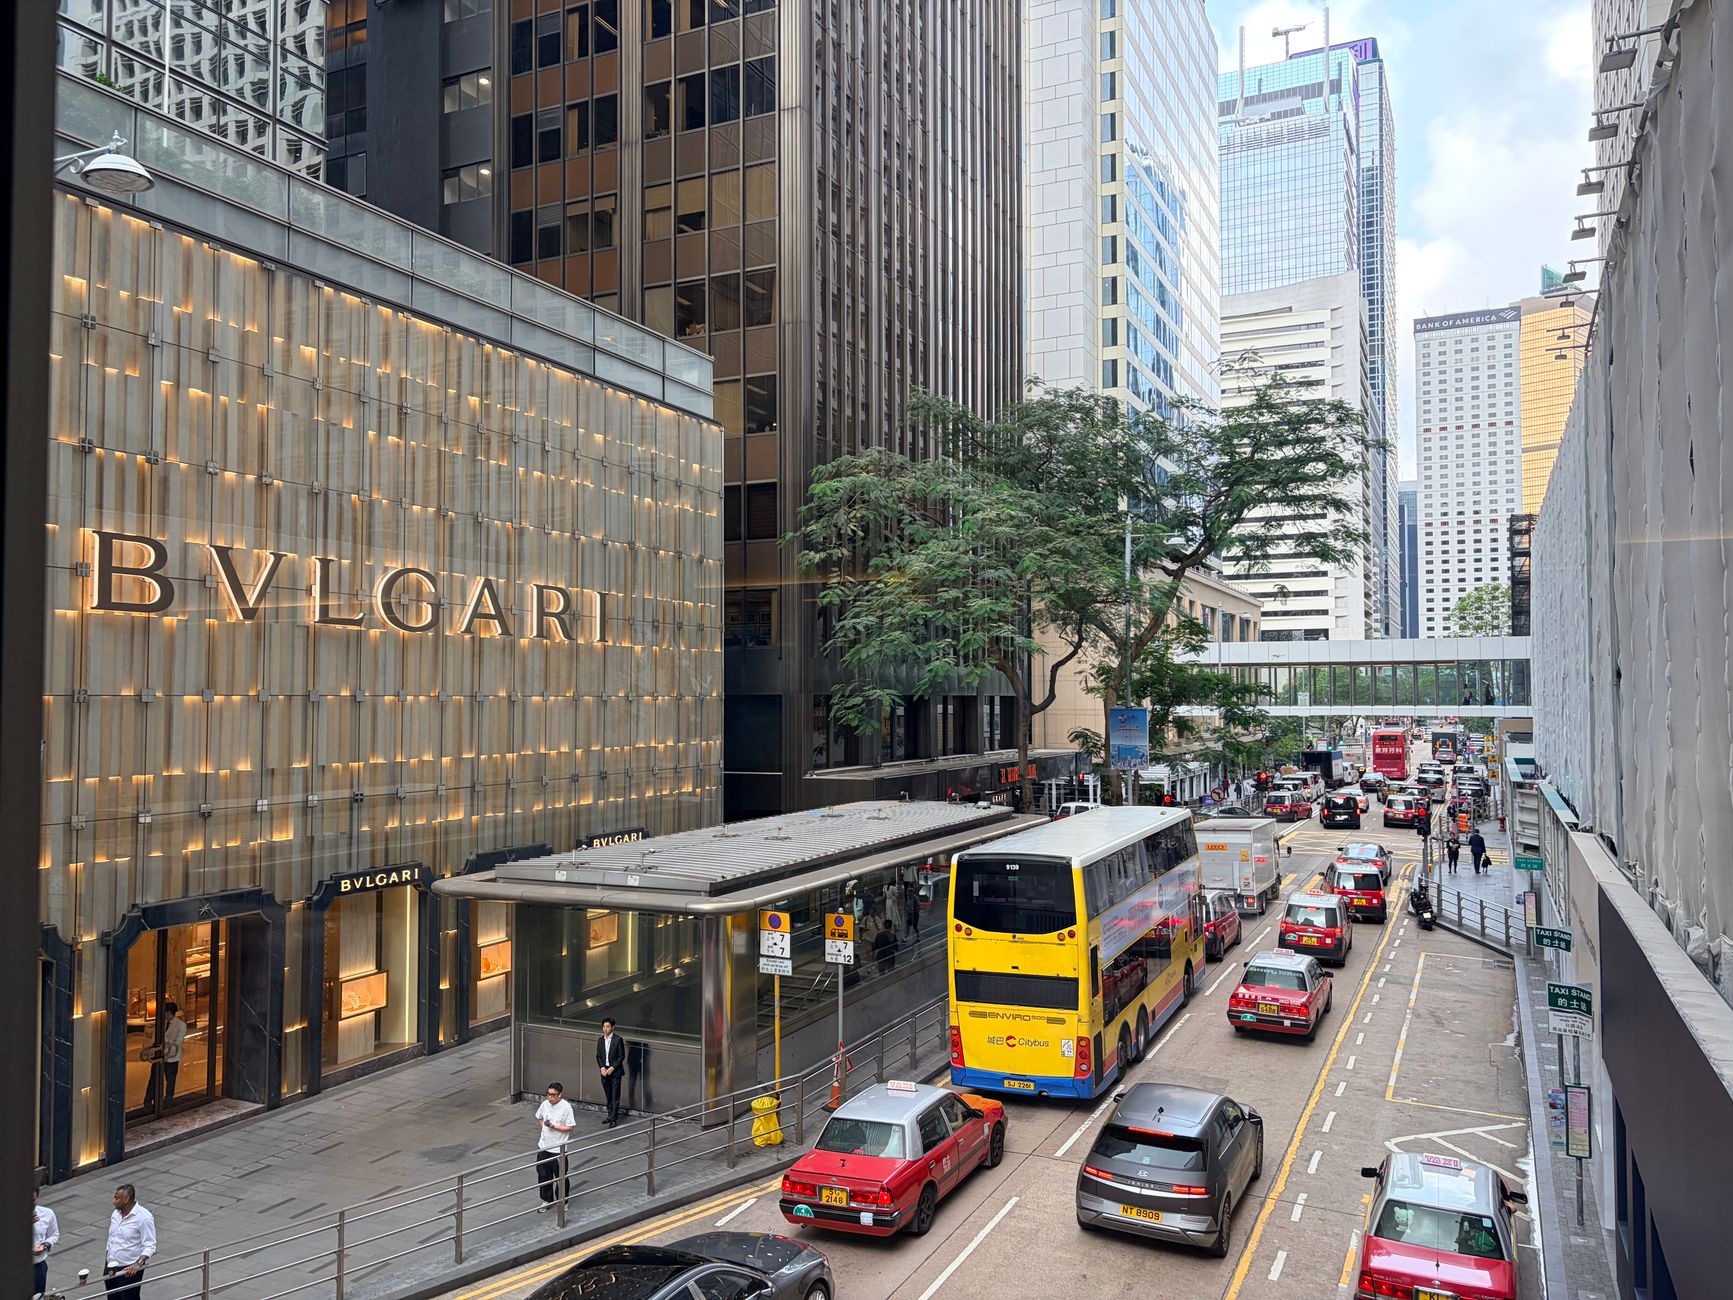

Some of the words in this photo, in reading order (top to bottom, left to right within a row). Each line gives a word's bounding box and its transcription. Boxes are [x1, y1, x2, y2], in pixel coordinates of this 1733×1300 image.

[1416, 321, 1440, 330] BANK
[1455, 314, 1497, 325] AMERICA
[89, 529, 610, 643] BVLGARI
[593, 832, 643, 849] BVLGARI
[340, 868, 419, 892] BVLGARI
[779, 934, 785, 943] 7
[1553, 930, 1571, 941] STAND
[842, 941, 848, 950] 7
[1543, 938, 1566, 949] 的士站
[779, 947, 785, 956] 7
[843, 955, 852, 963] 12
[1549, 986, 1569, 995] TAXI
[1571, 988, 1592, 1001] STAND
[1557, 998, 1587, 1011] 的士站
[988, 1011, 1031, 1021] ENVIRO
[987, 1035, 1005, 1046] 城巴
[1018, 1038, 1050, 1048] Citybus
[888, 1081, 915, 1090] TAXI
[1425, 1155, 1459, 1168] TAXI
[825, 1195, 844, 1204] 2148
[1121, 1205, 1134, 1215] NT
[1136, 1207, 1160, 1221] 8909
